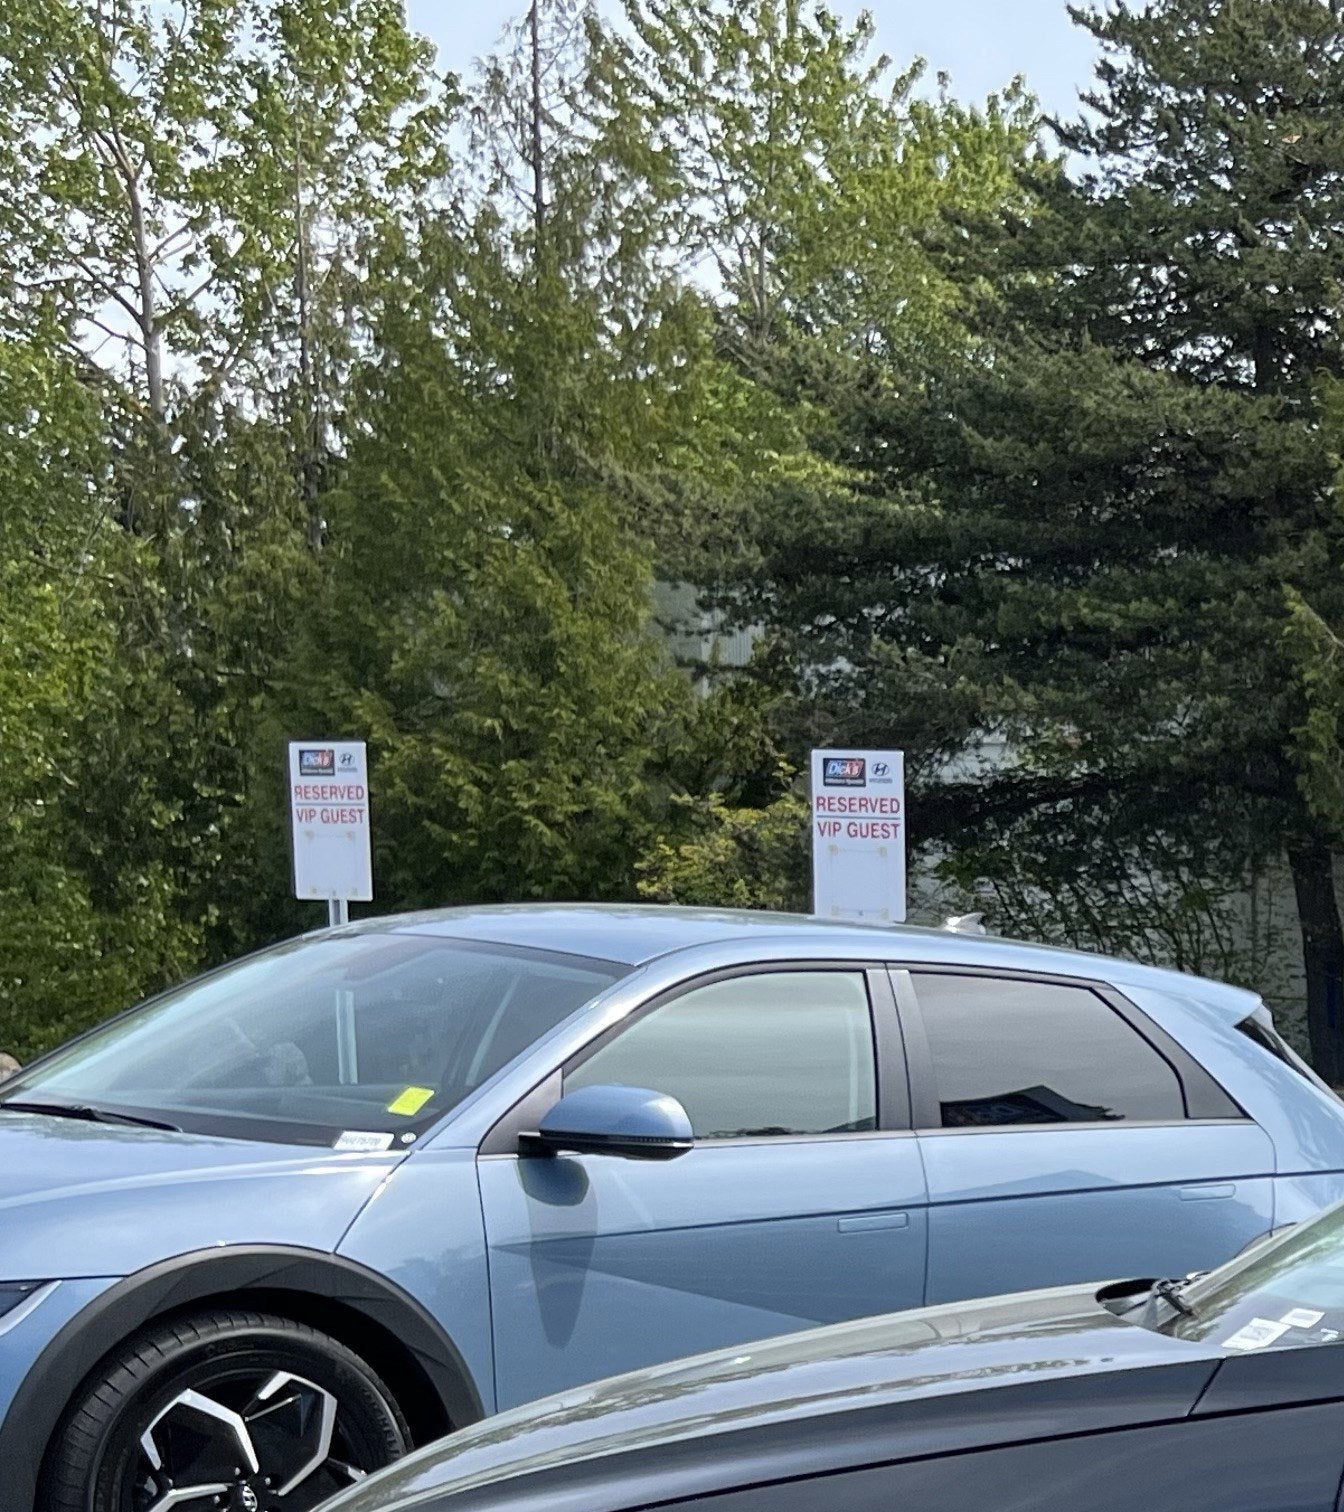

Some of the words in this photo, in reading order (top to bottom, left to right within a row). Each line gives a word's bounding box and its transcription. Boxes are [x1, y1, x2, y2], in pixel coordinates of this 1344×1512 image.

[294, 784, 365, 801] RESERVED
[816, 796, 900, 814] RESERVED
[295, 808, 317, 823] VIP
[320, 808, 365, 825] GUEST
[817, 821, 842, 838] VIP
[847, 821, 900, 839] GUEST
